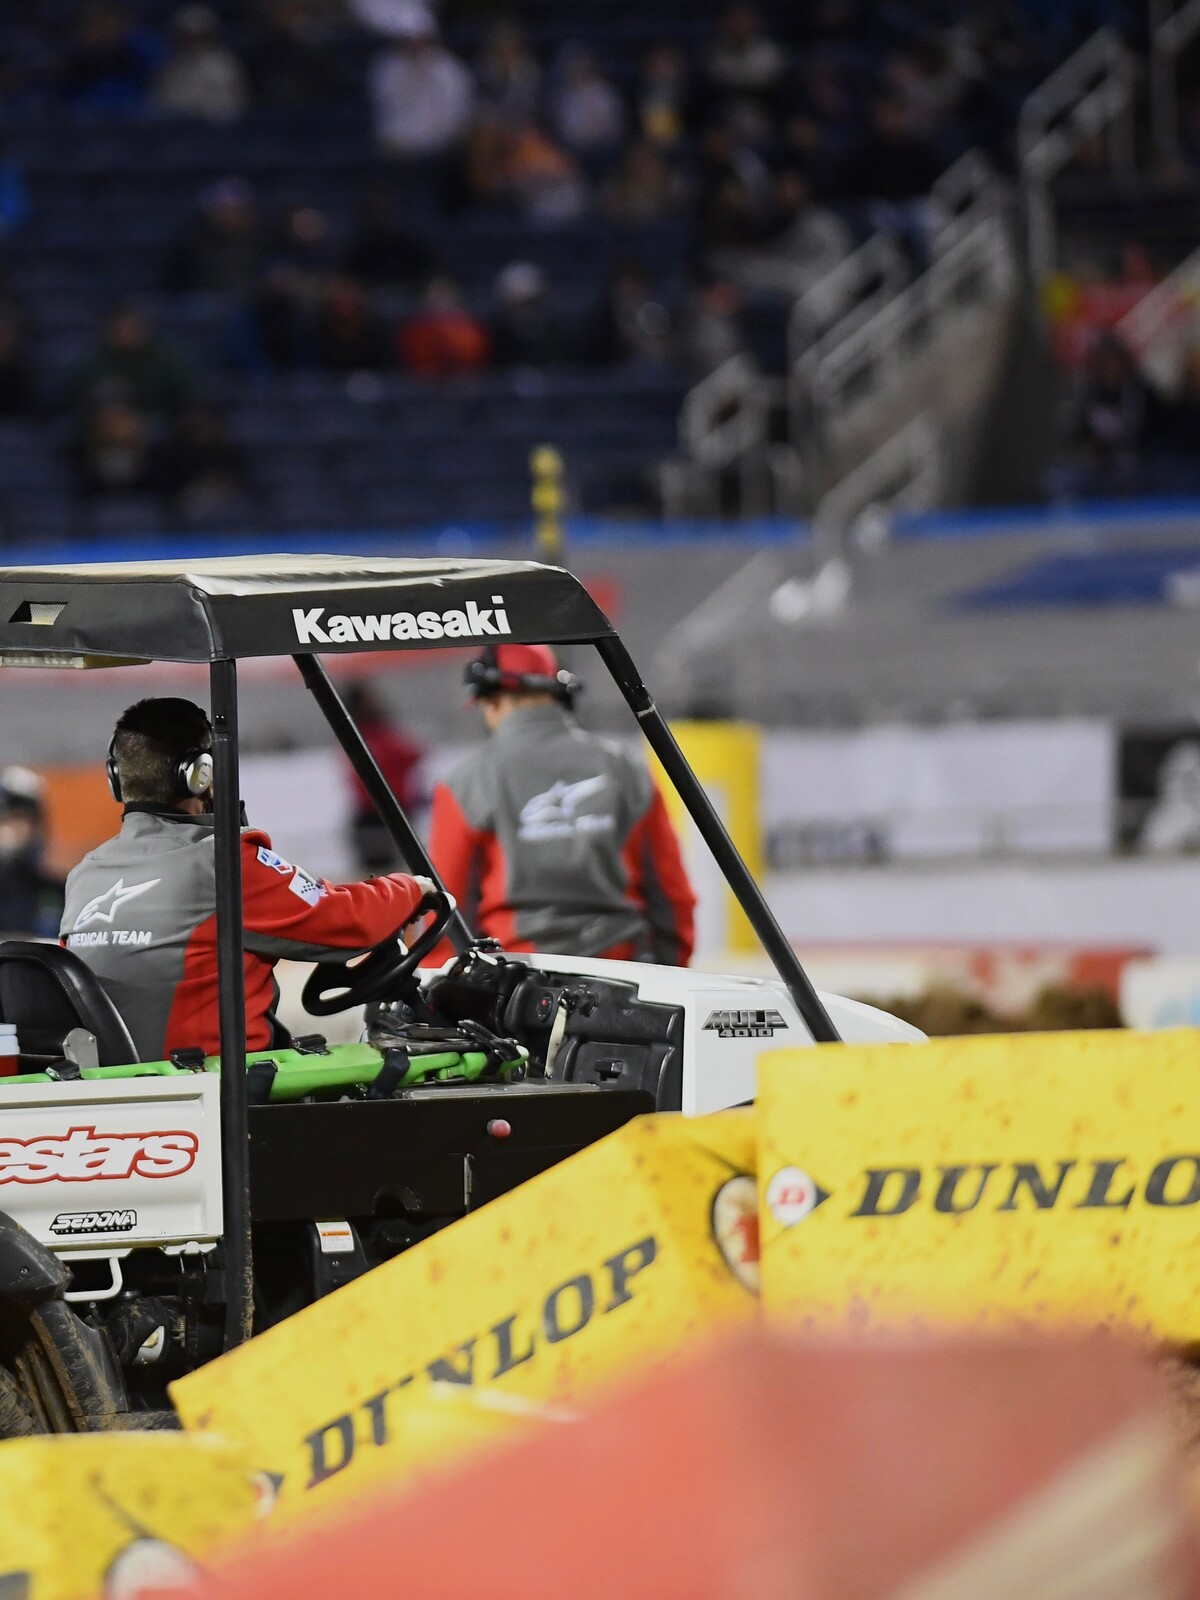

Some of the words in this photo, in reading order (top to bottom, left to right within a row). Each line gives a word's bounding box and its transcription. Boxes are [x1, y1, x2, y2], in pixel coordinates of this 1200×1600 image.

[292, 596, 511, 643] Kawasaki
[69, 931, 108, 946] MEDICAL
[112, 930, 152, 945] TEAM
[702, 1009, 788, 1030] MULE
[719, 1029, 773, 1037] 4010
[50, 1210, 136, 1229] SEDONA
